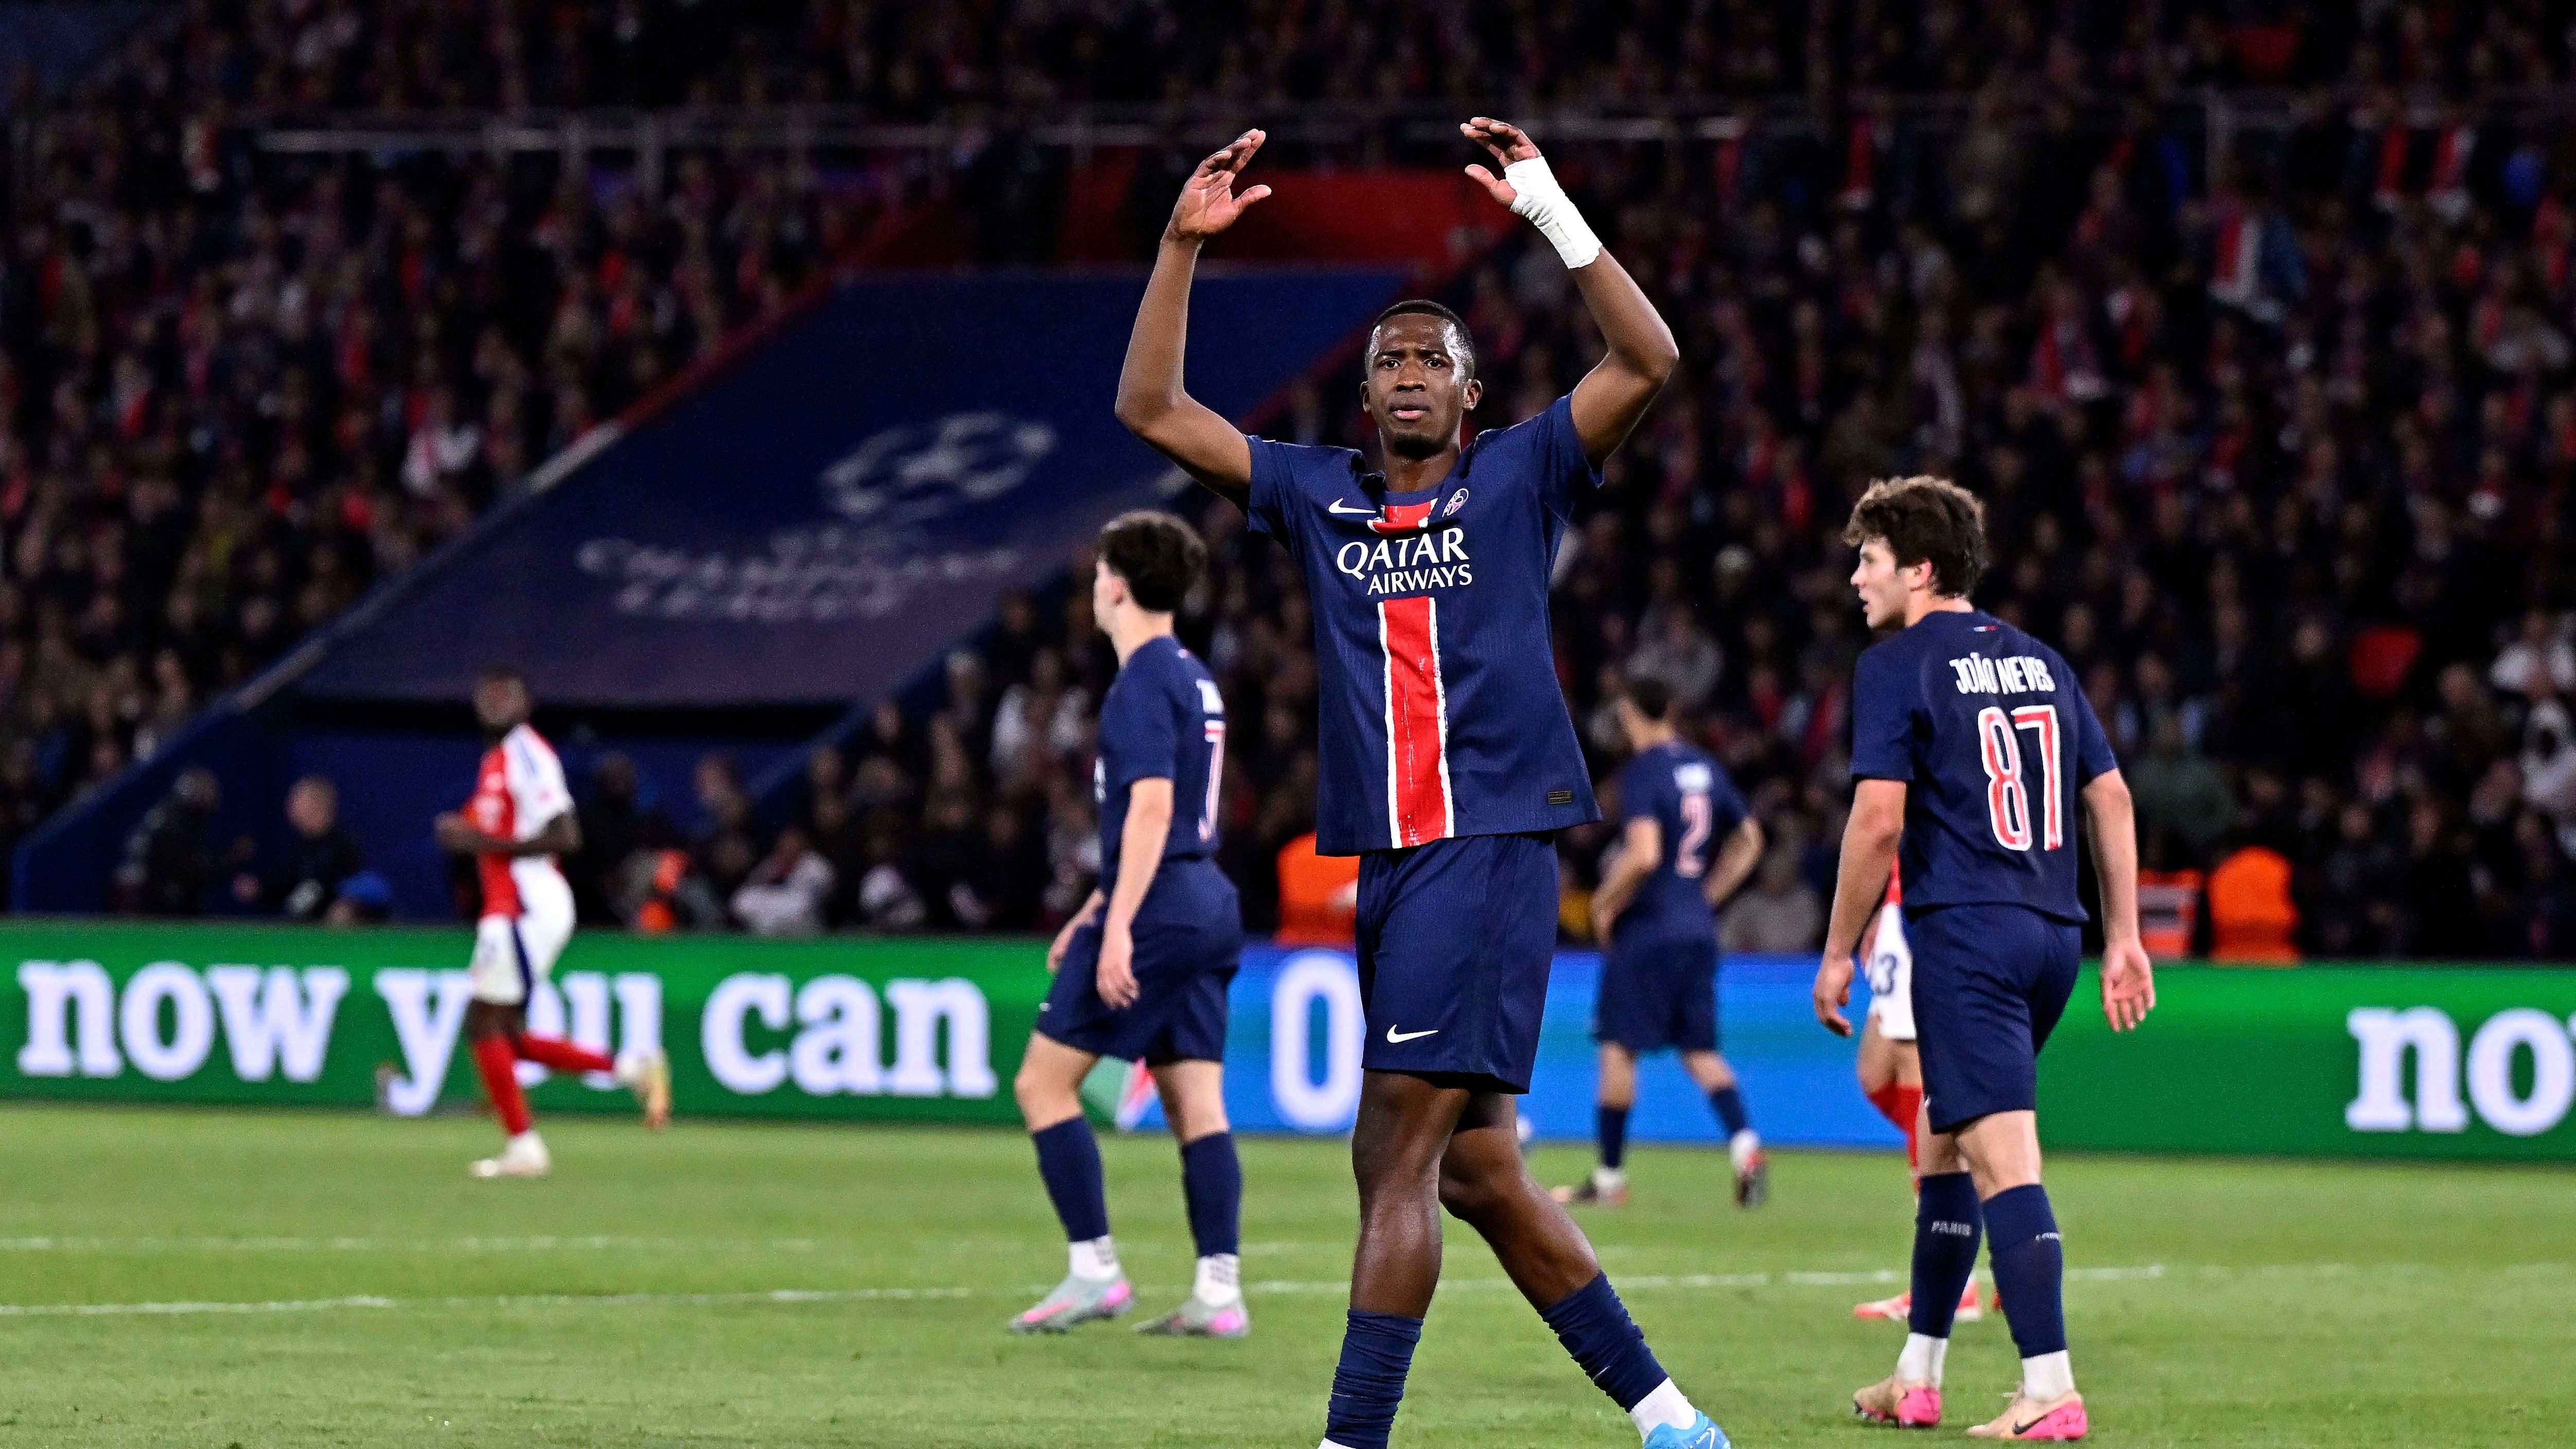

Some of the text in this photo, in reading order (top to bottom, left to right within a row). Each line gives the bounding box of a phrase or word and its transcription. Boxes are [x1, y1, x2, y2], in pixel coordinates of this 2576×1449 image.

[1337, 527, 1470, 580] QATAR
[1367, 563, 1473, 596] AIRWAYS
[1949, 651, 1999, 695] JOÃO
[1977, 704, 2063, 851] 87
[16, 959, 351, 1082] now
[699, 971, 998, 1099] can
[2344, 1004, 2576, 1137] no
